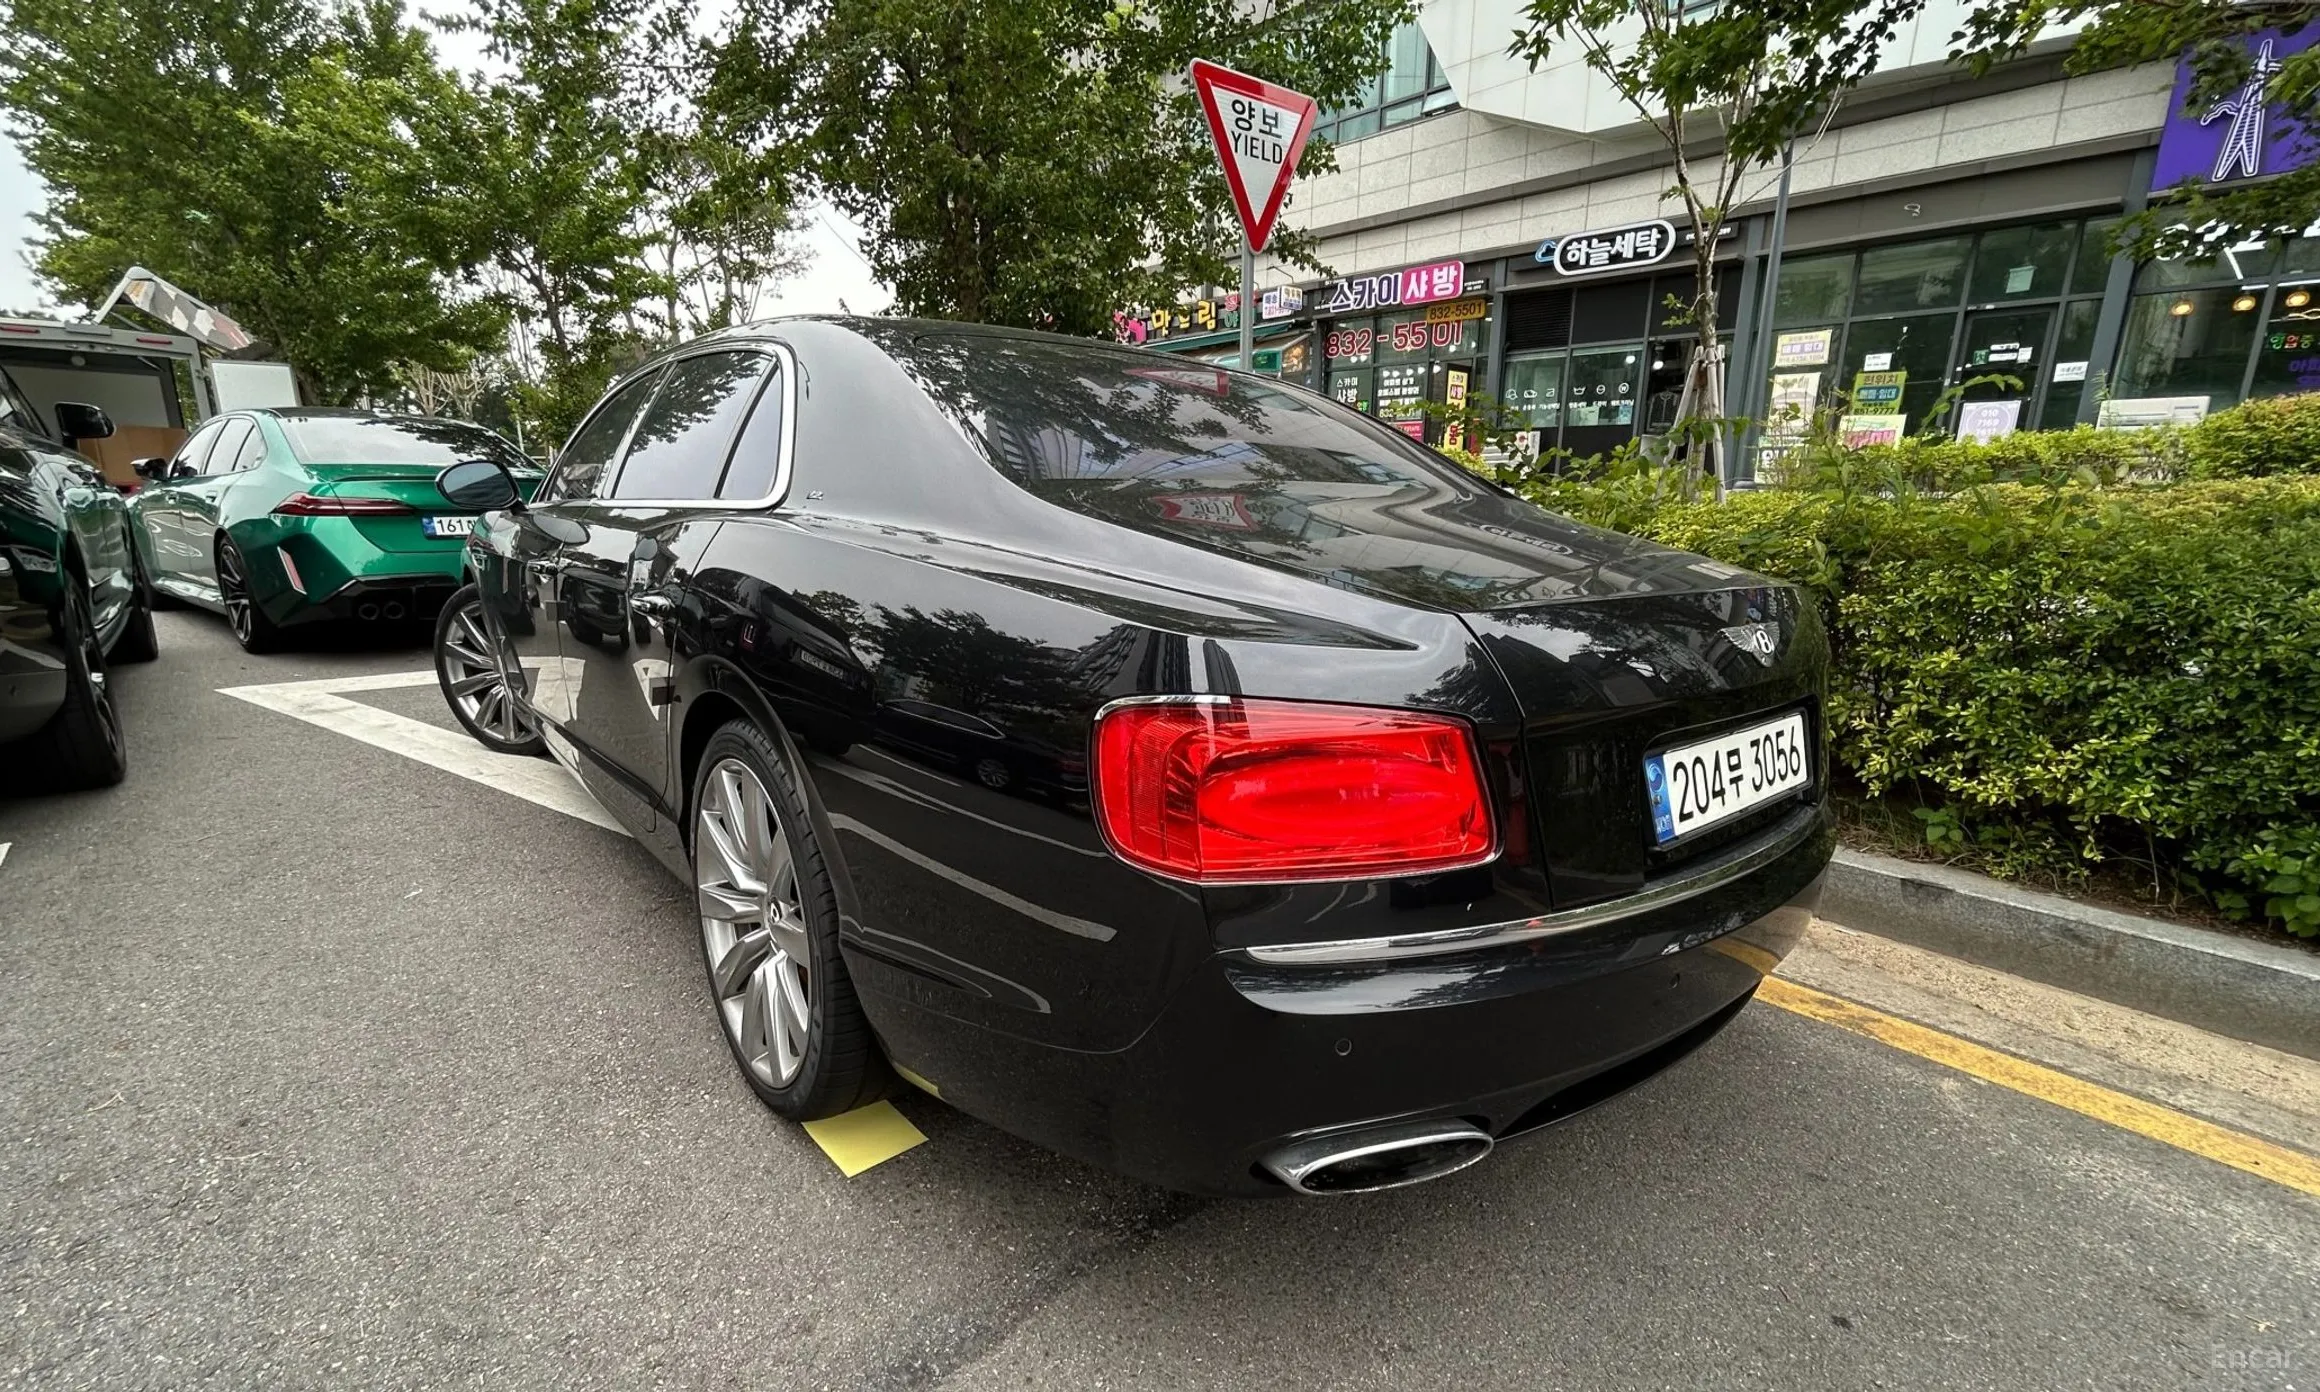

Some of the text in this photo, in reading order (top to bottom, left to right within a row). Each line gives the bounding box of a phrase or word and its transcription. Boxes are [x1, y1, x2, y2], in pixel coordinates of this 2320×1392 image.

[1231, 99, 1283, 140] 양보
[1231, 130, 1283, 165] YIELD
[1566, 228, 1662, 266] 하늘세탁
[1330, 273, 1403, 312] 스카이
[1405, 265, 1457, 300] 샤방
[1429, 301, 1483, 321] 832-5501
[2270, 335, 2313, 349] 영업중
[1336, 376, 1358, 387] 스카이
[1336, 389, 1357, 403] 샤방
[1673, 725, 1801, 823] 204무 3056
